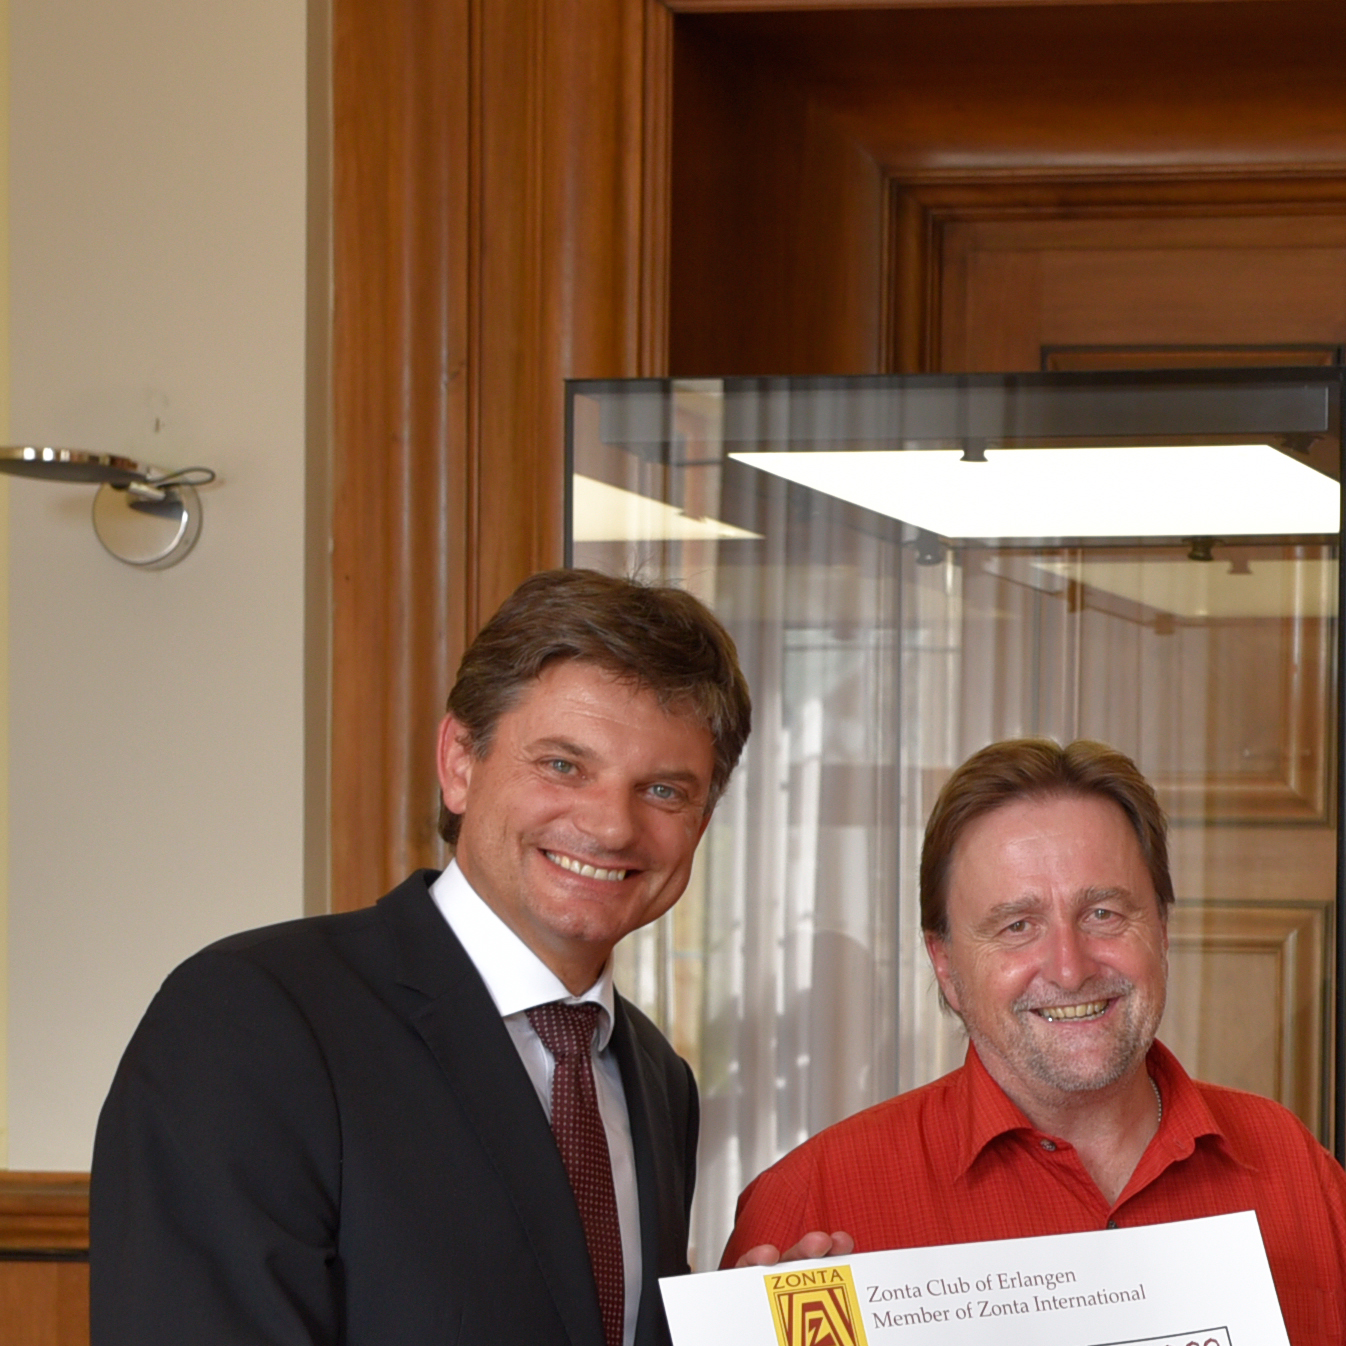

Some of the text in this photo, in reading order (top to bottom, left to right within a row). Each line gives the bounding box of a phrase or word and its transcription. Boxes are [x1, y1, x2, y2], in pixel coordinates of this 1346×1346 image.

[771, 1268, 844, 1290] ZONTA
[866, 1270, 1076, 1303] Zonta Club of Erlangen
[872, 1284, 1147, 1329] Member of Zonta International
